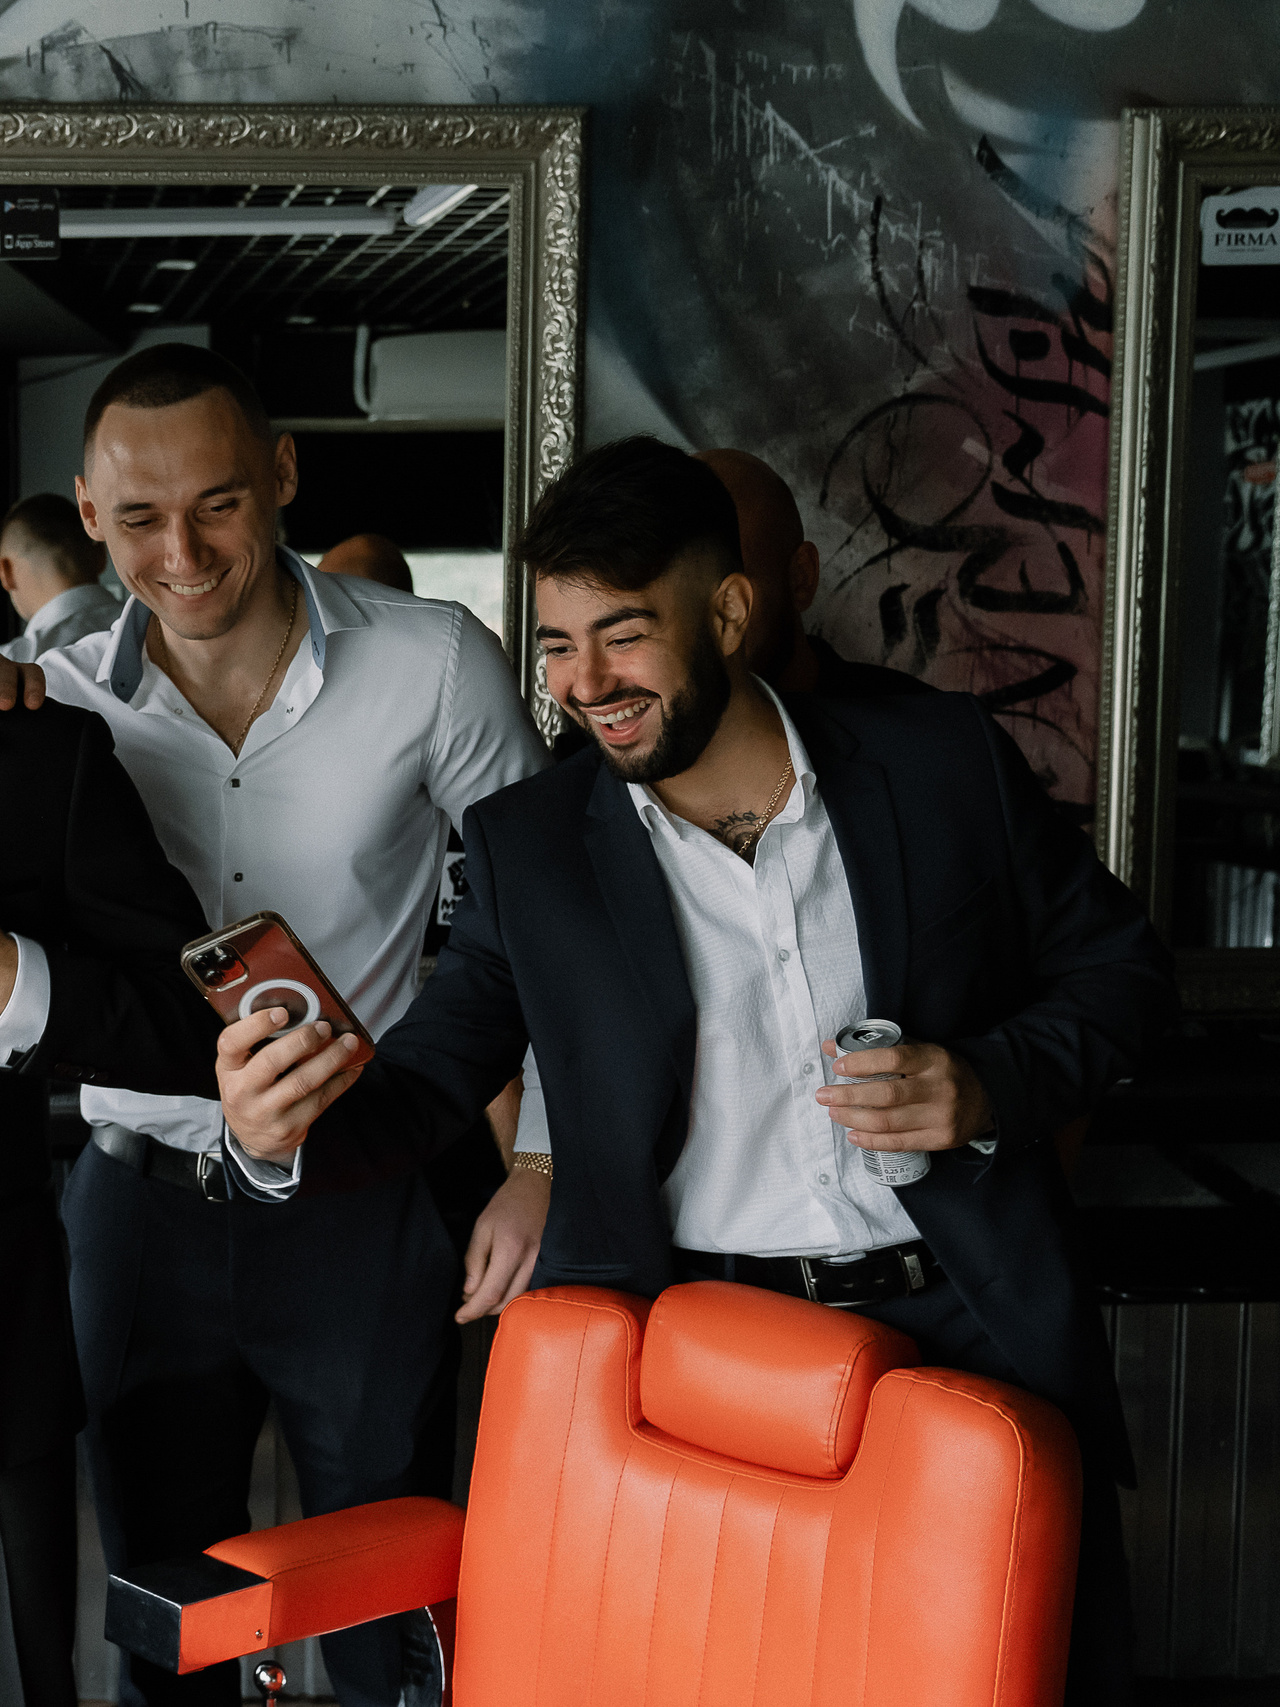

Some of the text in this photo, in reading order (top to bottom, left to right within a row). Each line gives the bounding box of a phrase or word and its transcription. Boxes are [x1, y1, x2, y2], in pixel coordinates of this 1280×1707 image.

[15, 239, 55, 250] App Store
[1215, 232, 1277, 246] FIRMA
